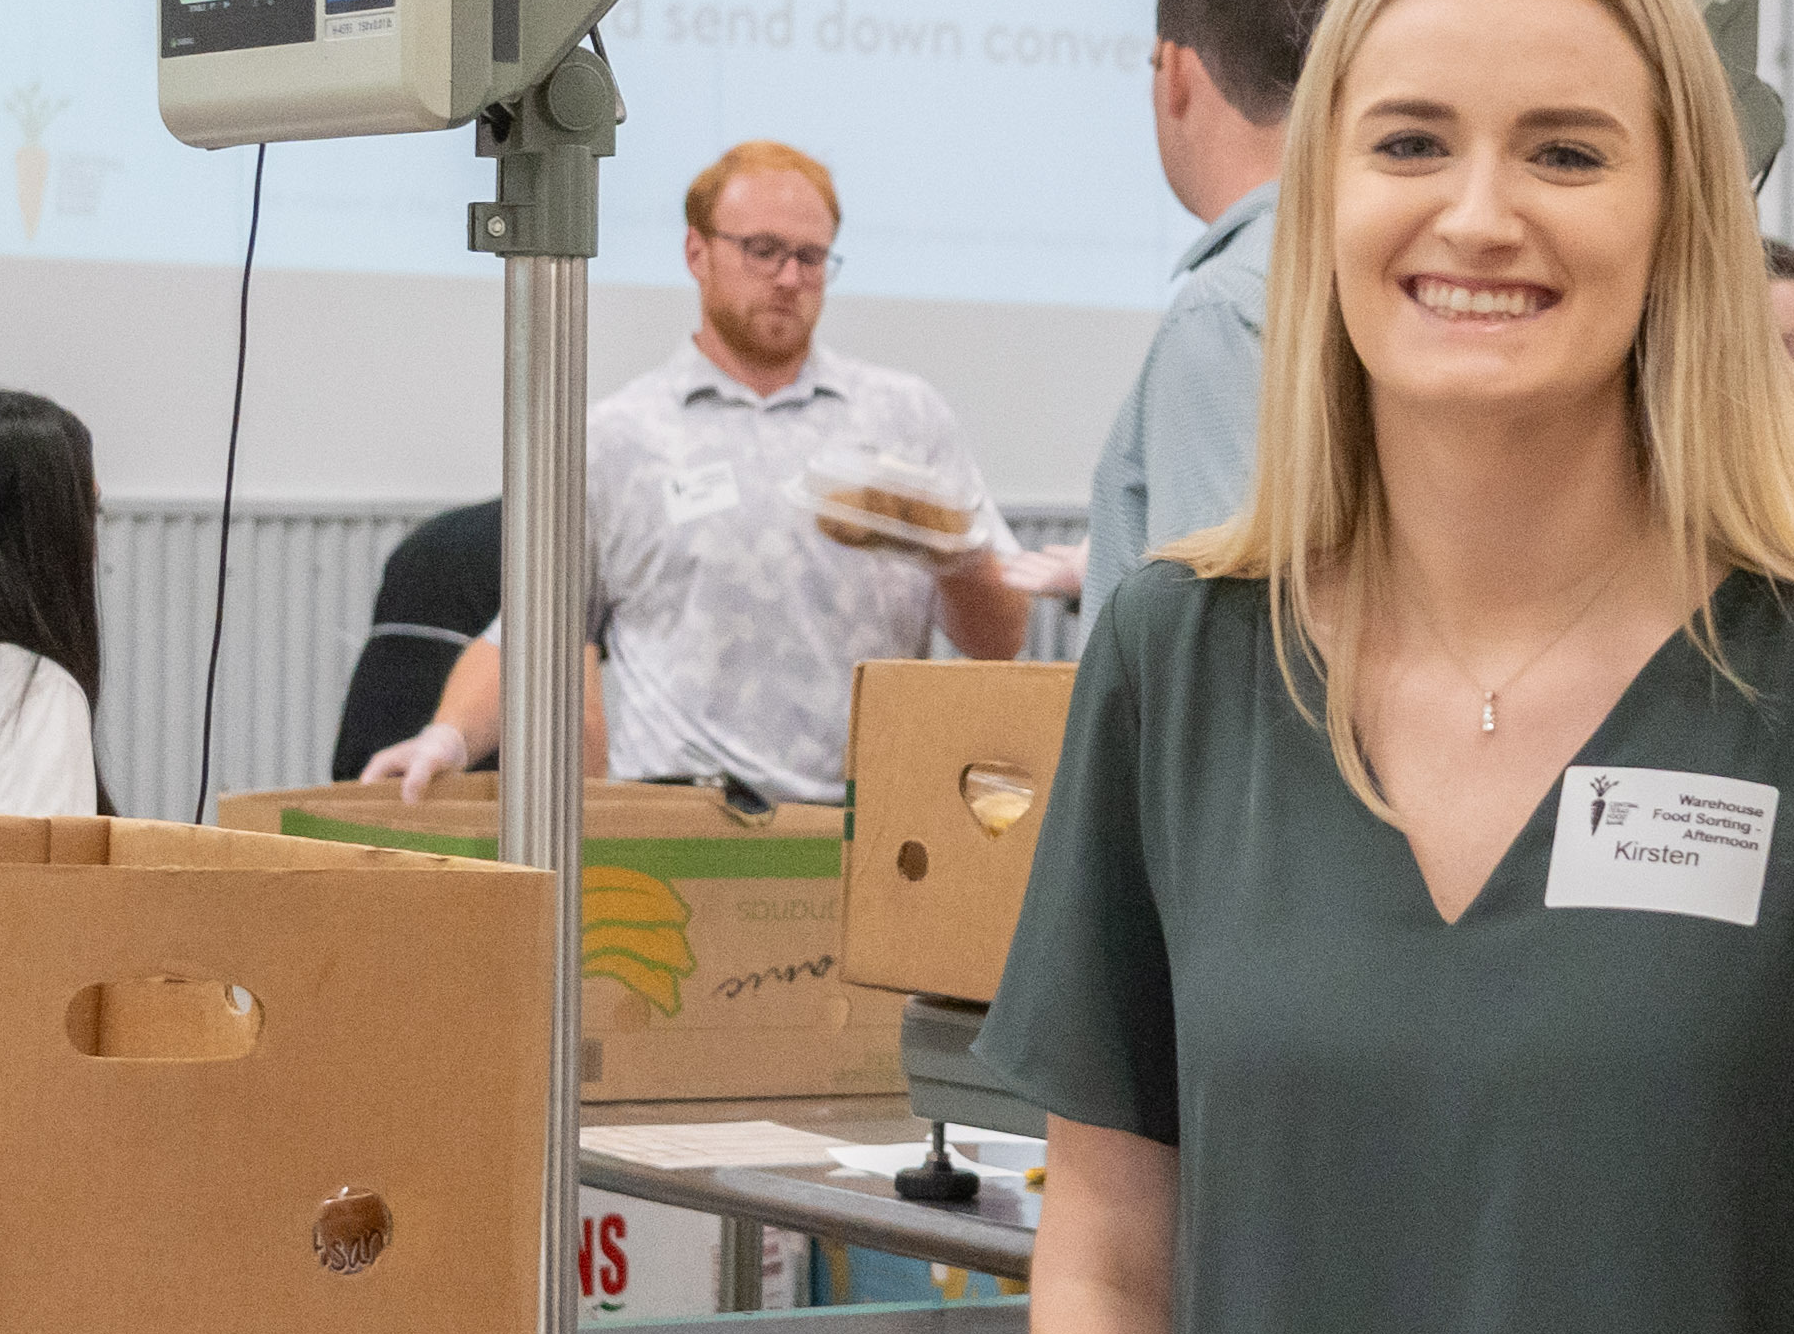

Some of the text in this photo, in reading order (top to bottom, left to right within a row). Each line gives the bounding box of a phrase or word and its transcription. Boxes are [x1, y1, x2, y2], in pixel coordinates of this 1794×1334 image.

[983, 22, 1145, 70] conve
[1679, 794, 1765, 818] Warehouse
[1653, 808, 1691, 824] Food
[1695, 812, 1751, 834] Sorting
[1682, 829, 1759, 851] Afternoon
[1614, 840, 1700, 867] Kirsten
[578, 1213, 630, 1297] NS
